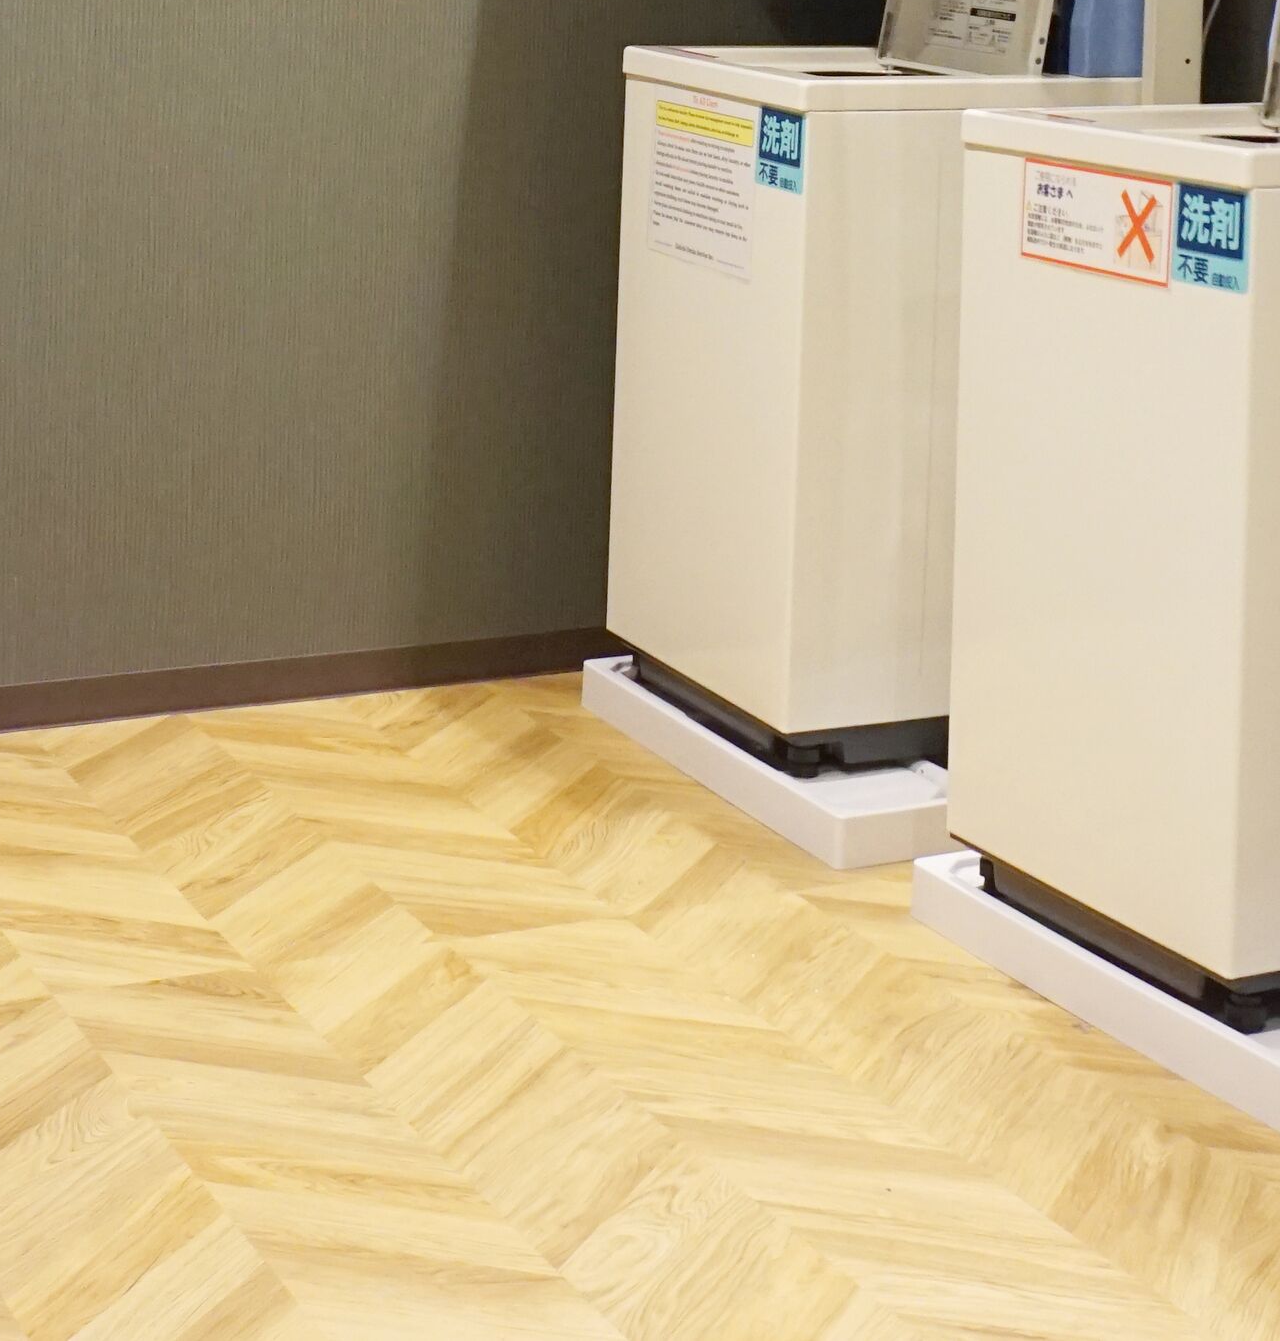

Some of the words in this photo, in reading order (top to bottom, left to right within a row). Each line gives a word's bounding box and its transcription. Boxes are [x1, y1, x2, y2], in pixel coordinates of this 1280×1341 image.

[762, 114, 799, 160] 洗剤
[759, 162, 778, 186] 不要
[1181, 192, 1241, 251] 洗剤
[1178, 254, 1209, 284] 不要
